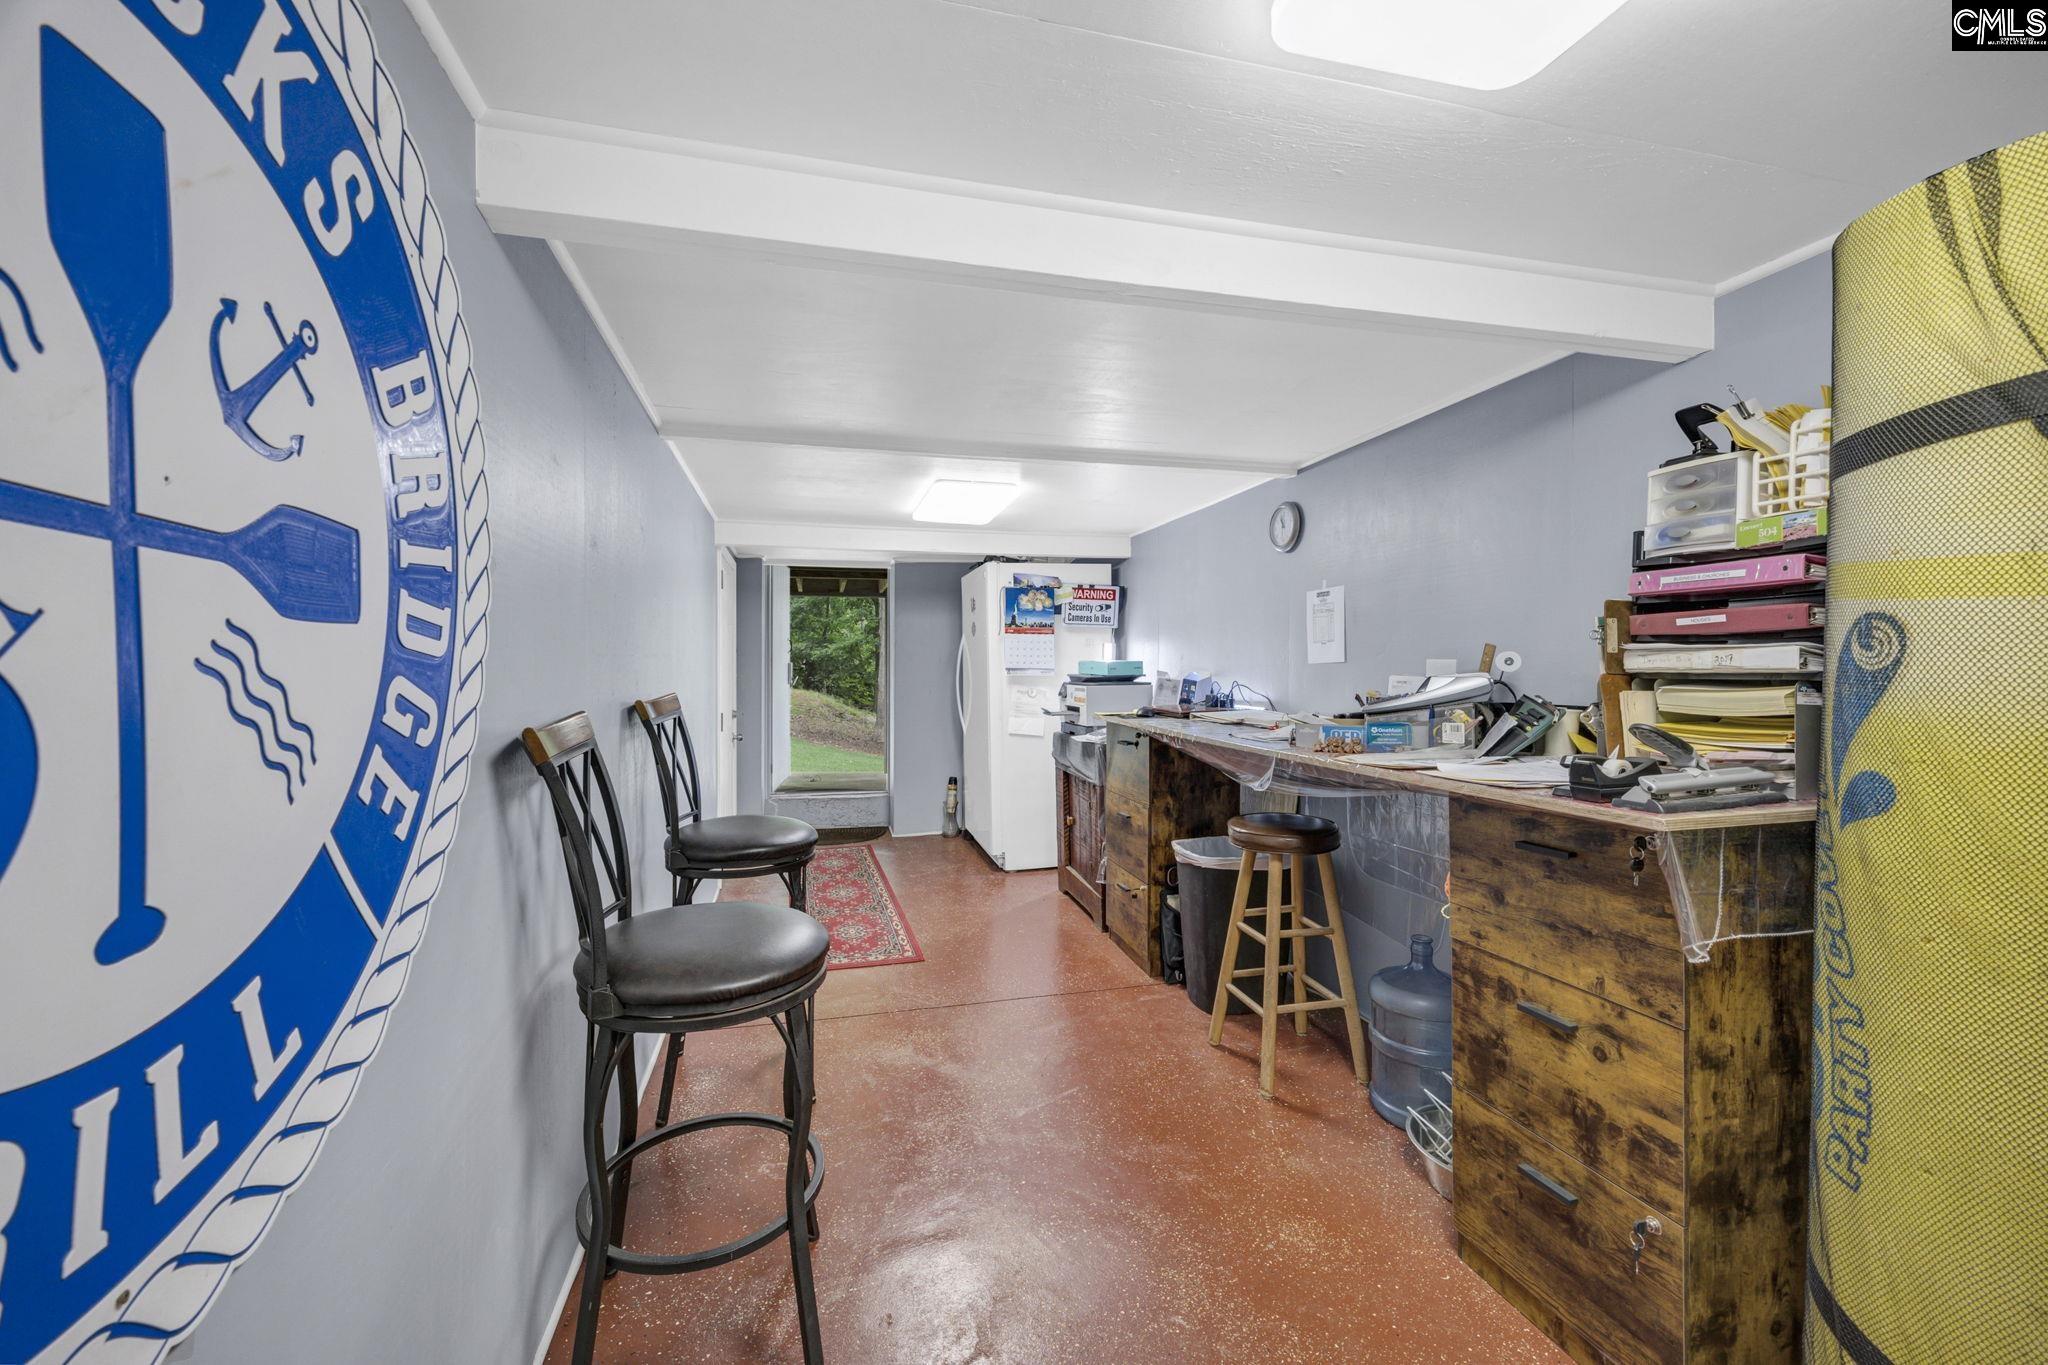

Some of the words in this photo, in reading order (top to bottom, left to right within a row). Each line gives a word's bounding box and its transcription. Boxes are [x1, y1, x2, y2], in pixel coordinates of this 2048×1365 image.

[1759, 526, 1777, 538] 504
[358, 349, 453, 842] BRIDGE
[1068, 602, 1093, 613] Security
[1067, 612, 1092, 623] Cameras
[1101, 615, 1111, 623] Use
[1824, 977, 1873, 1192] PARTY
